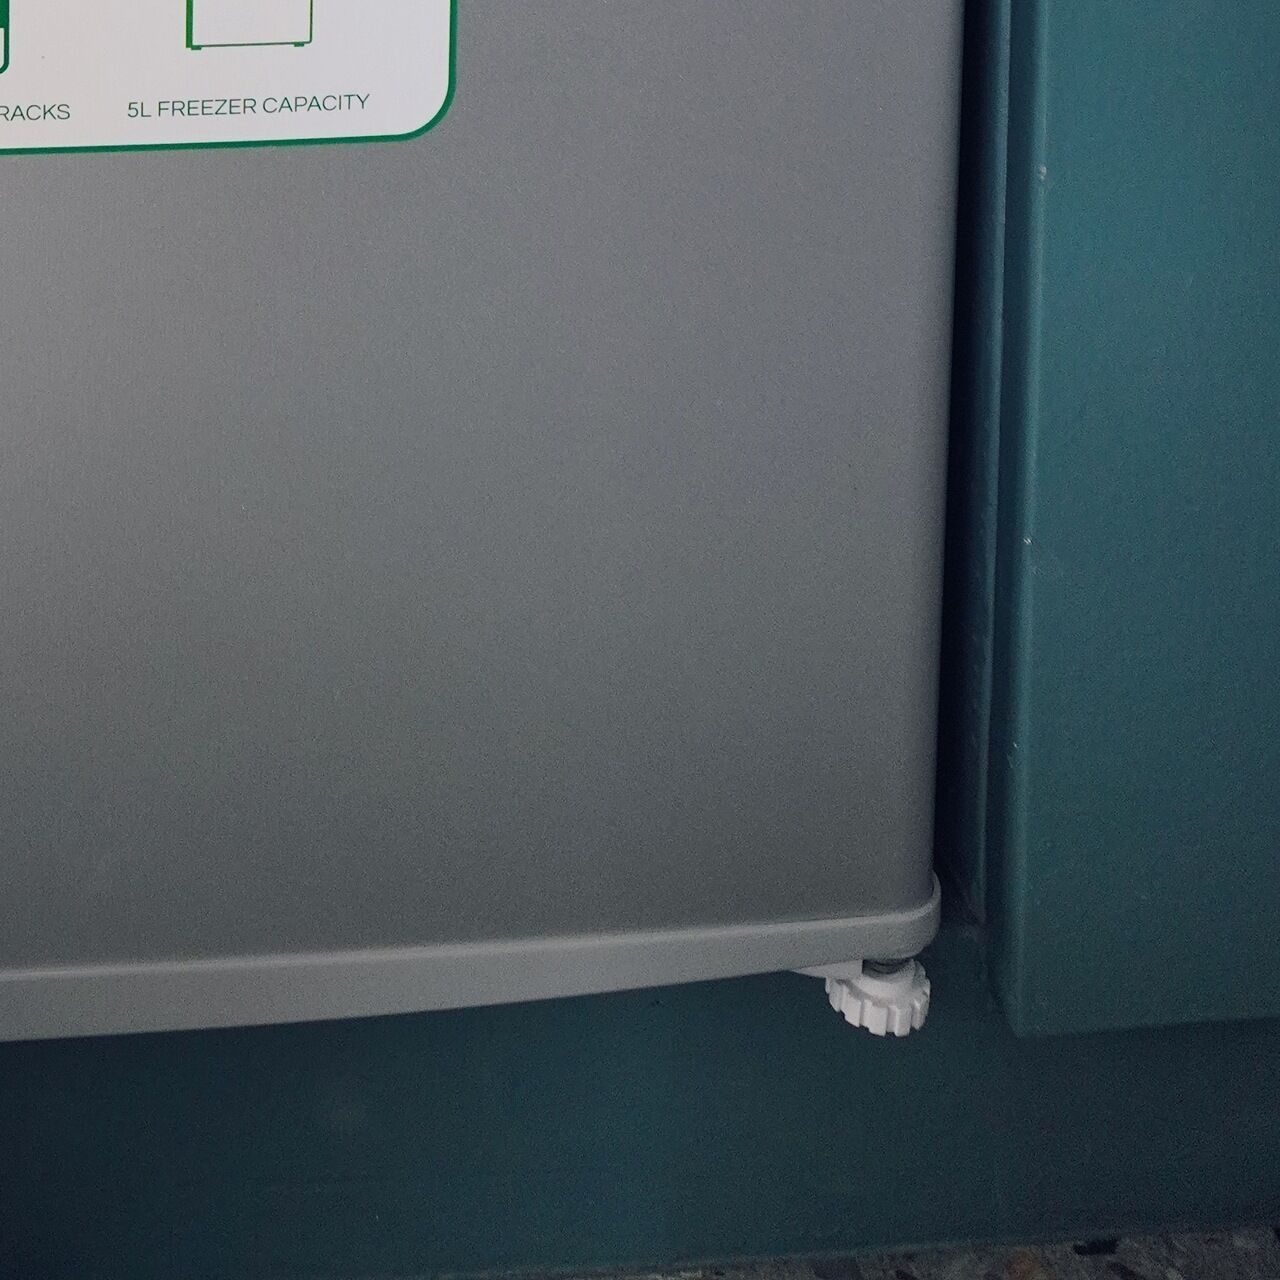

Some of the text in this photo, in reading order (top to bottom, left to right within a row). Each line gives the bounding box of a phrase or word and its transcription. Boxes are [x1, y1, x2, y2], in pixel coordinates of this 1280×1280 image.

[127, 93, 370, 119] 5L FREEZER CAPACITY
